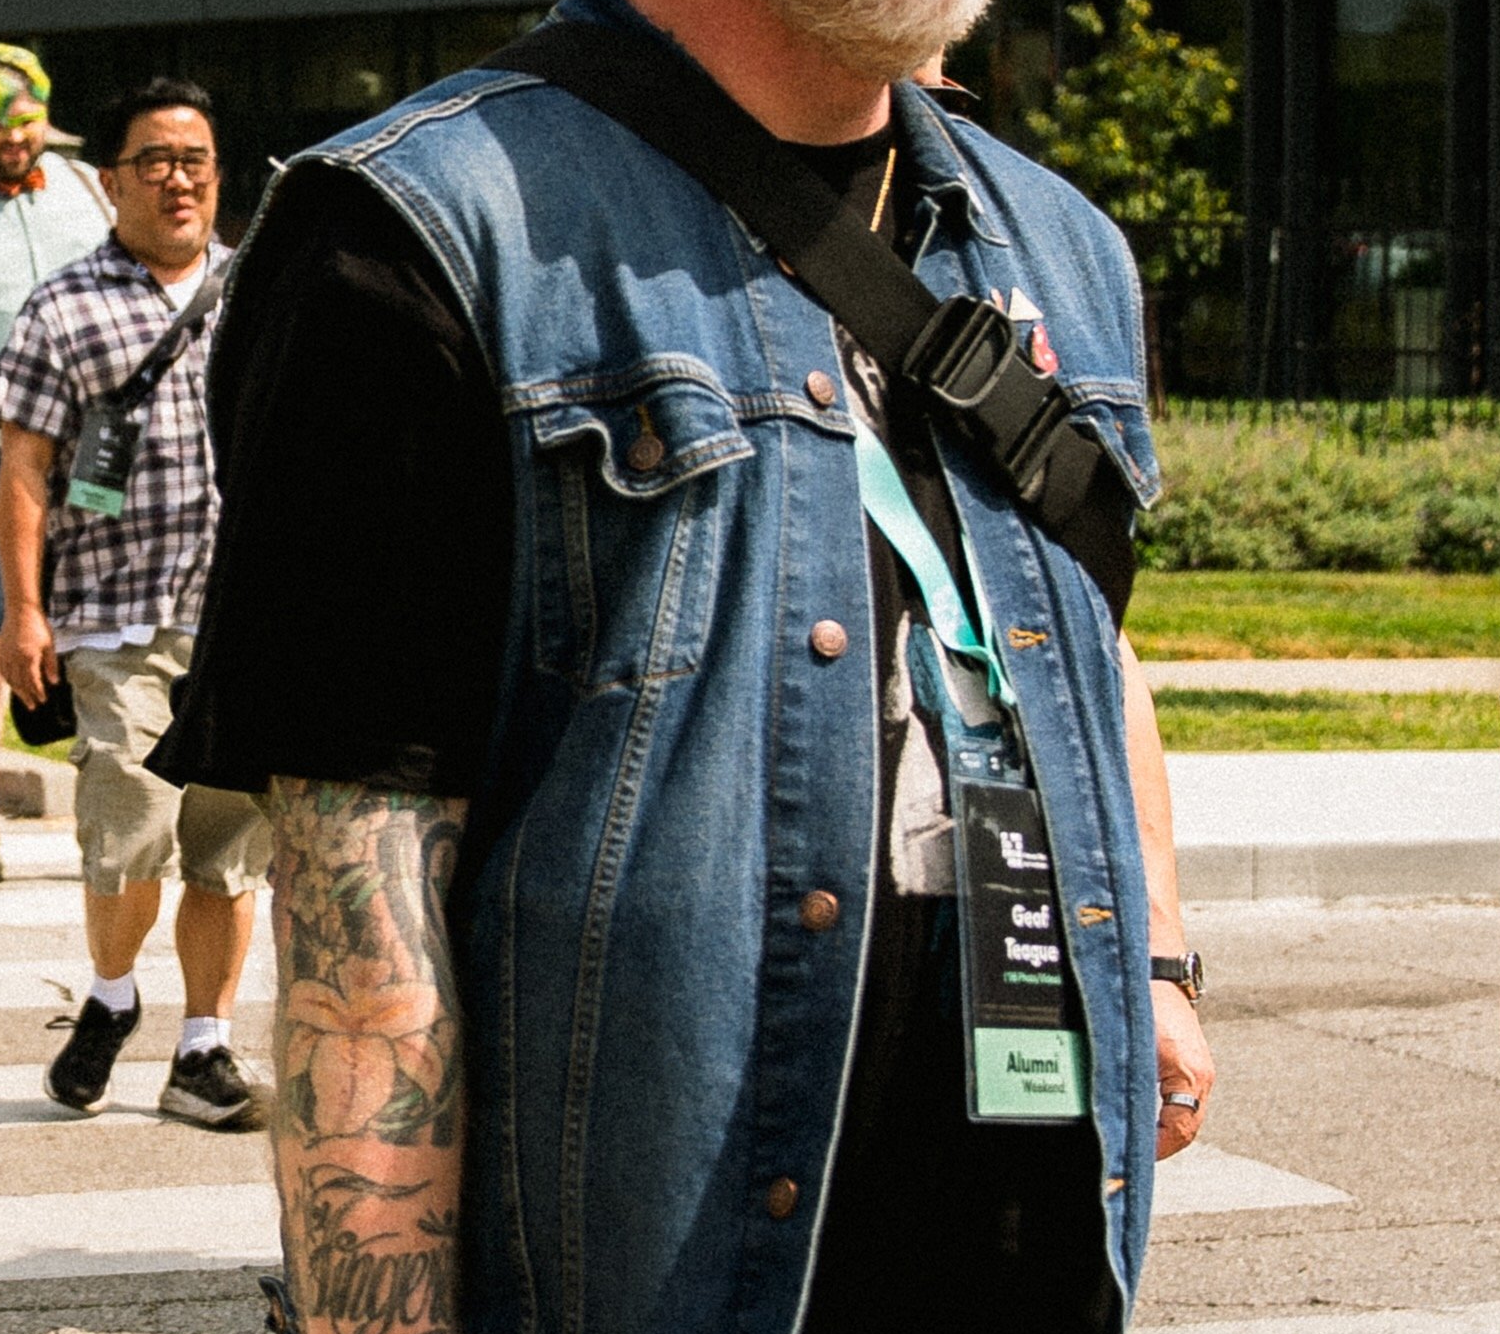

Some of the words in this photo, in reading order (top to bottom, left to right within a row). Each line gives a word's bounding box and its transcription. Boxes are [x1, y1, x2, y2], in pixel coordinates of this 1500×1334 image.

[1004, 936, 1060, 967] Teague
[1006, 1051, 1059, 1074] Alumni
[1021, 1078, 1065, 1095] Weekend
